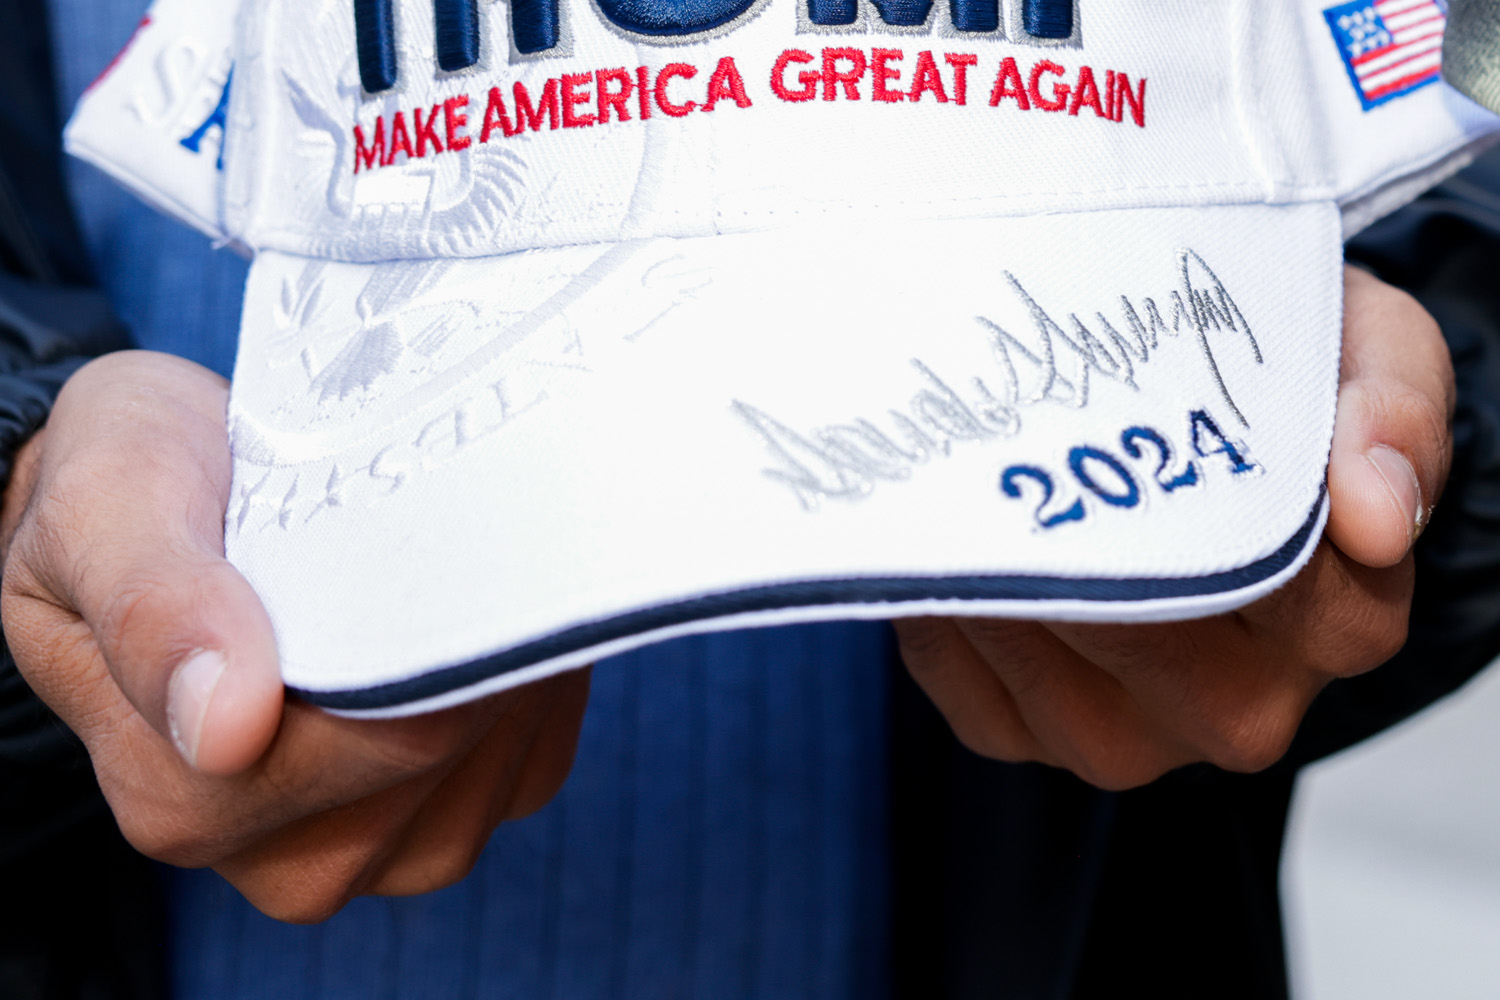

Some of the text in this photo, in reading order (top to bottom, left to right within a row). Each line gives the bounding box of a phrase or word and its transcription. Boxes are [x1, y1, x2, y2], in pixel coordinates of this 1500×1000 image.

[353, 46, 1147, 175] MAKE AMERICA GREAT AGAIN
[1000, 408, 1260, 530] 2024
